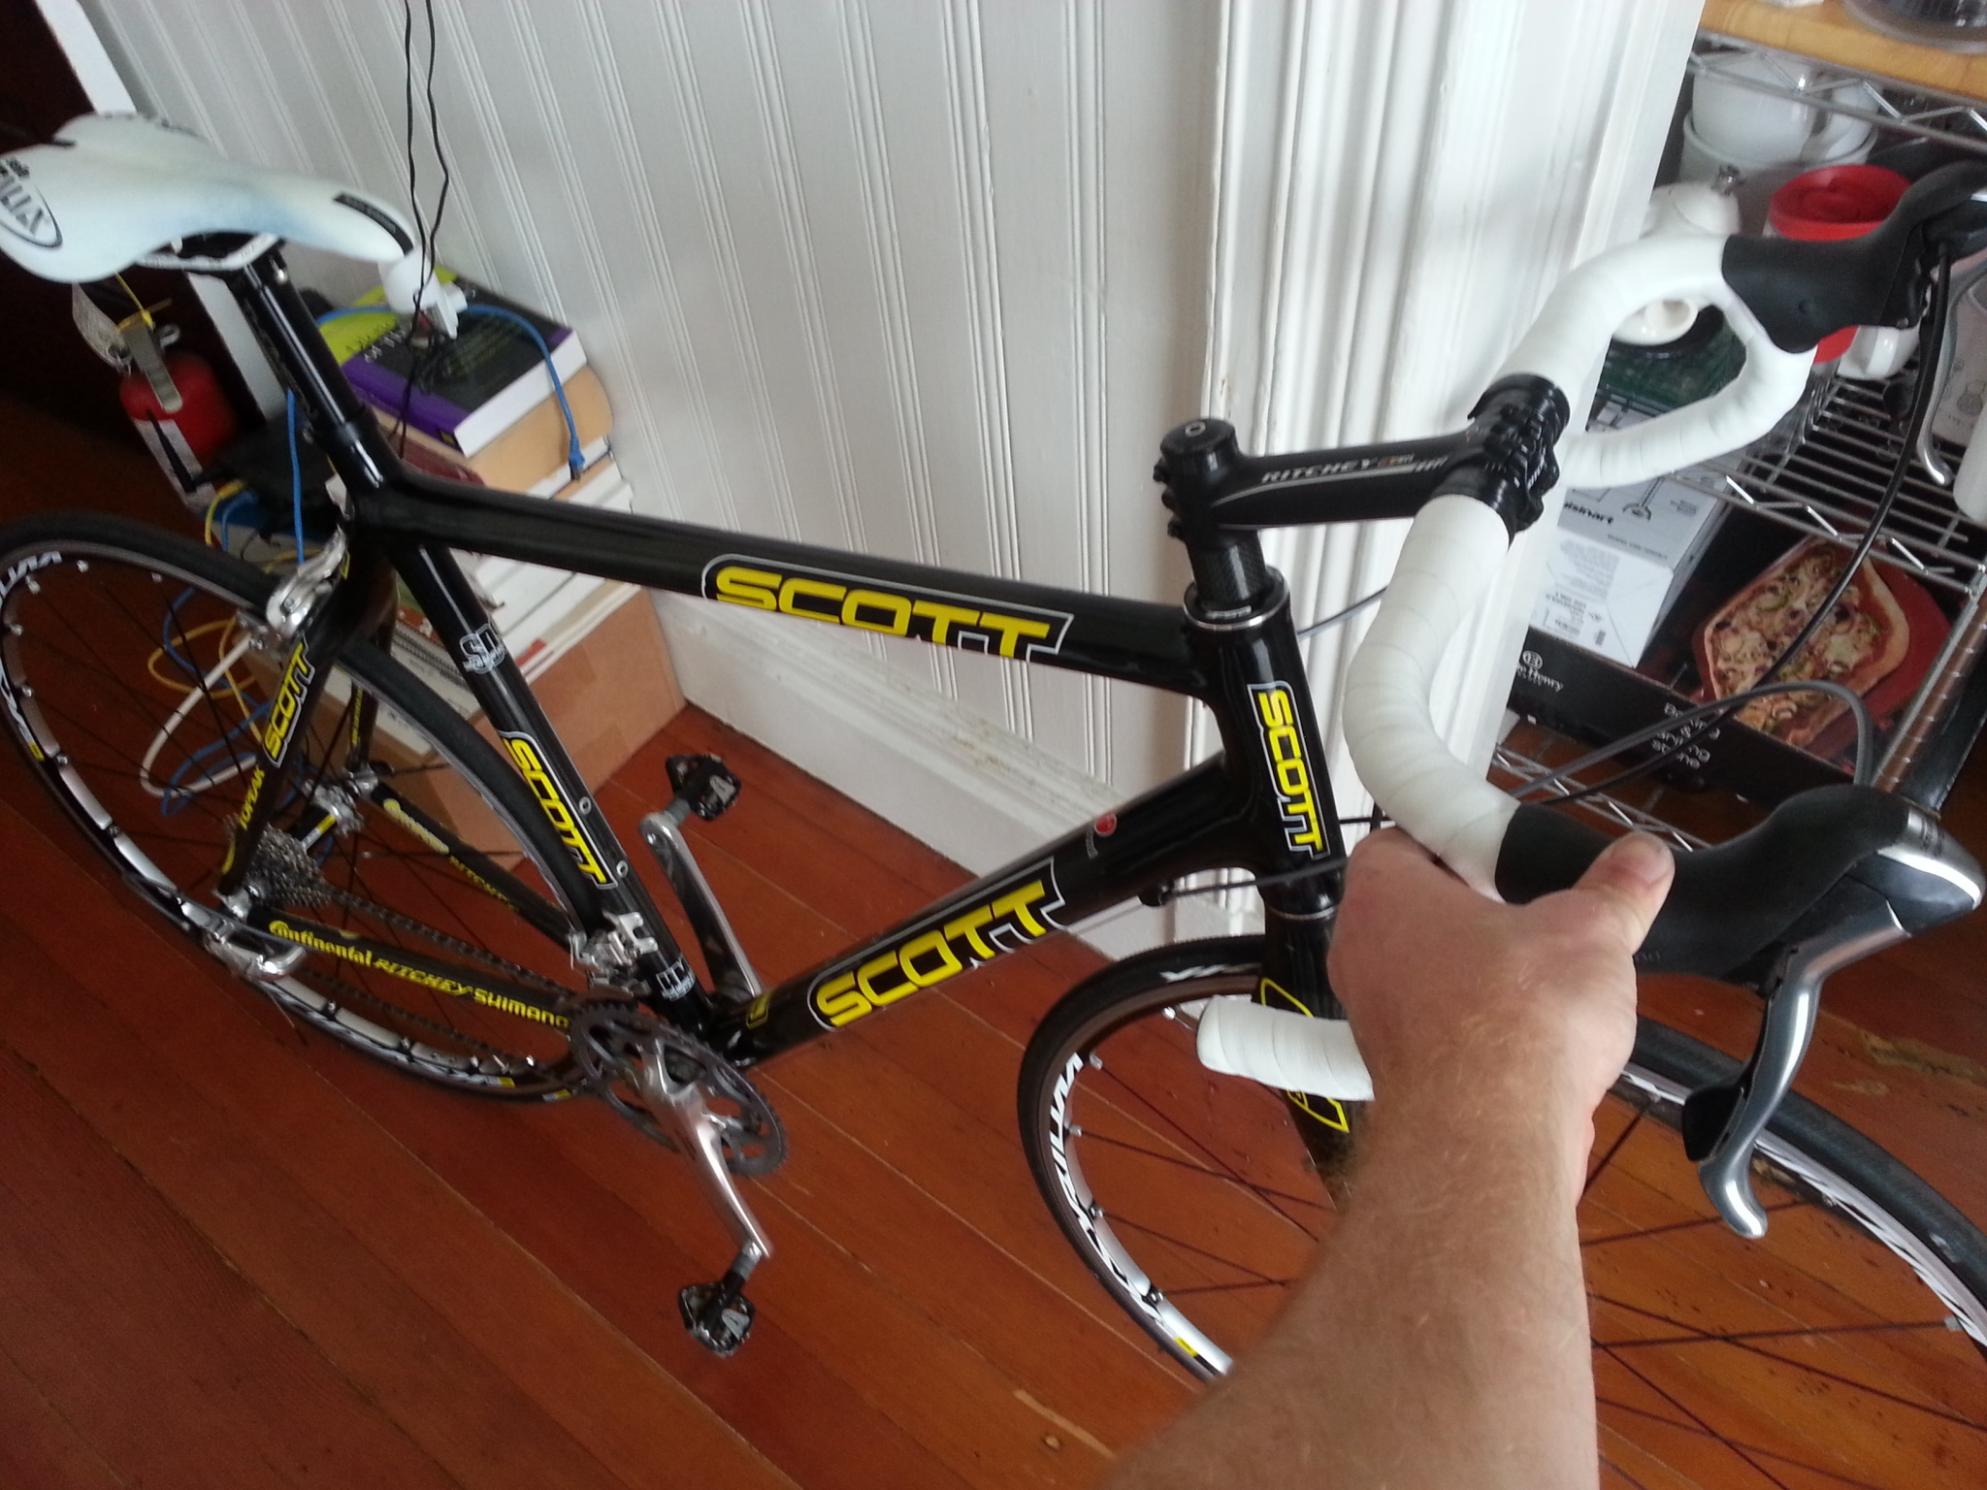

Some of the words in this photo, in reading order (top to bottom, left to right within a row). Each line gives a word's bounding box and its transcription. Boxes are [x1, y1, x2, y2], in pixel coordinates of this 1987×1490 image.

[715, 566, 1051, 660] SCOTT
[264, 641, 310, 760] SCOTT
[500, 738, 608, 884] SCOTT
[1257, 688, 1325, 853] SCOTT
[268, 920, 373, 967] Continental
[373, 958, 474, 996] RITCHEY
[473, 988, 571, 1029] SHIMANO
[815, 880, 1047, 1027] SCOTT
